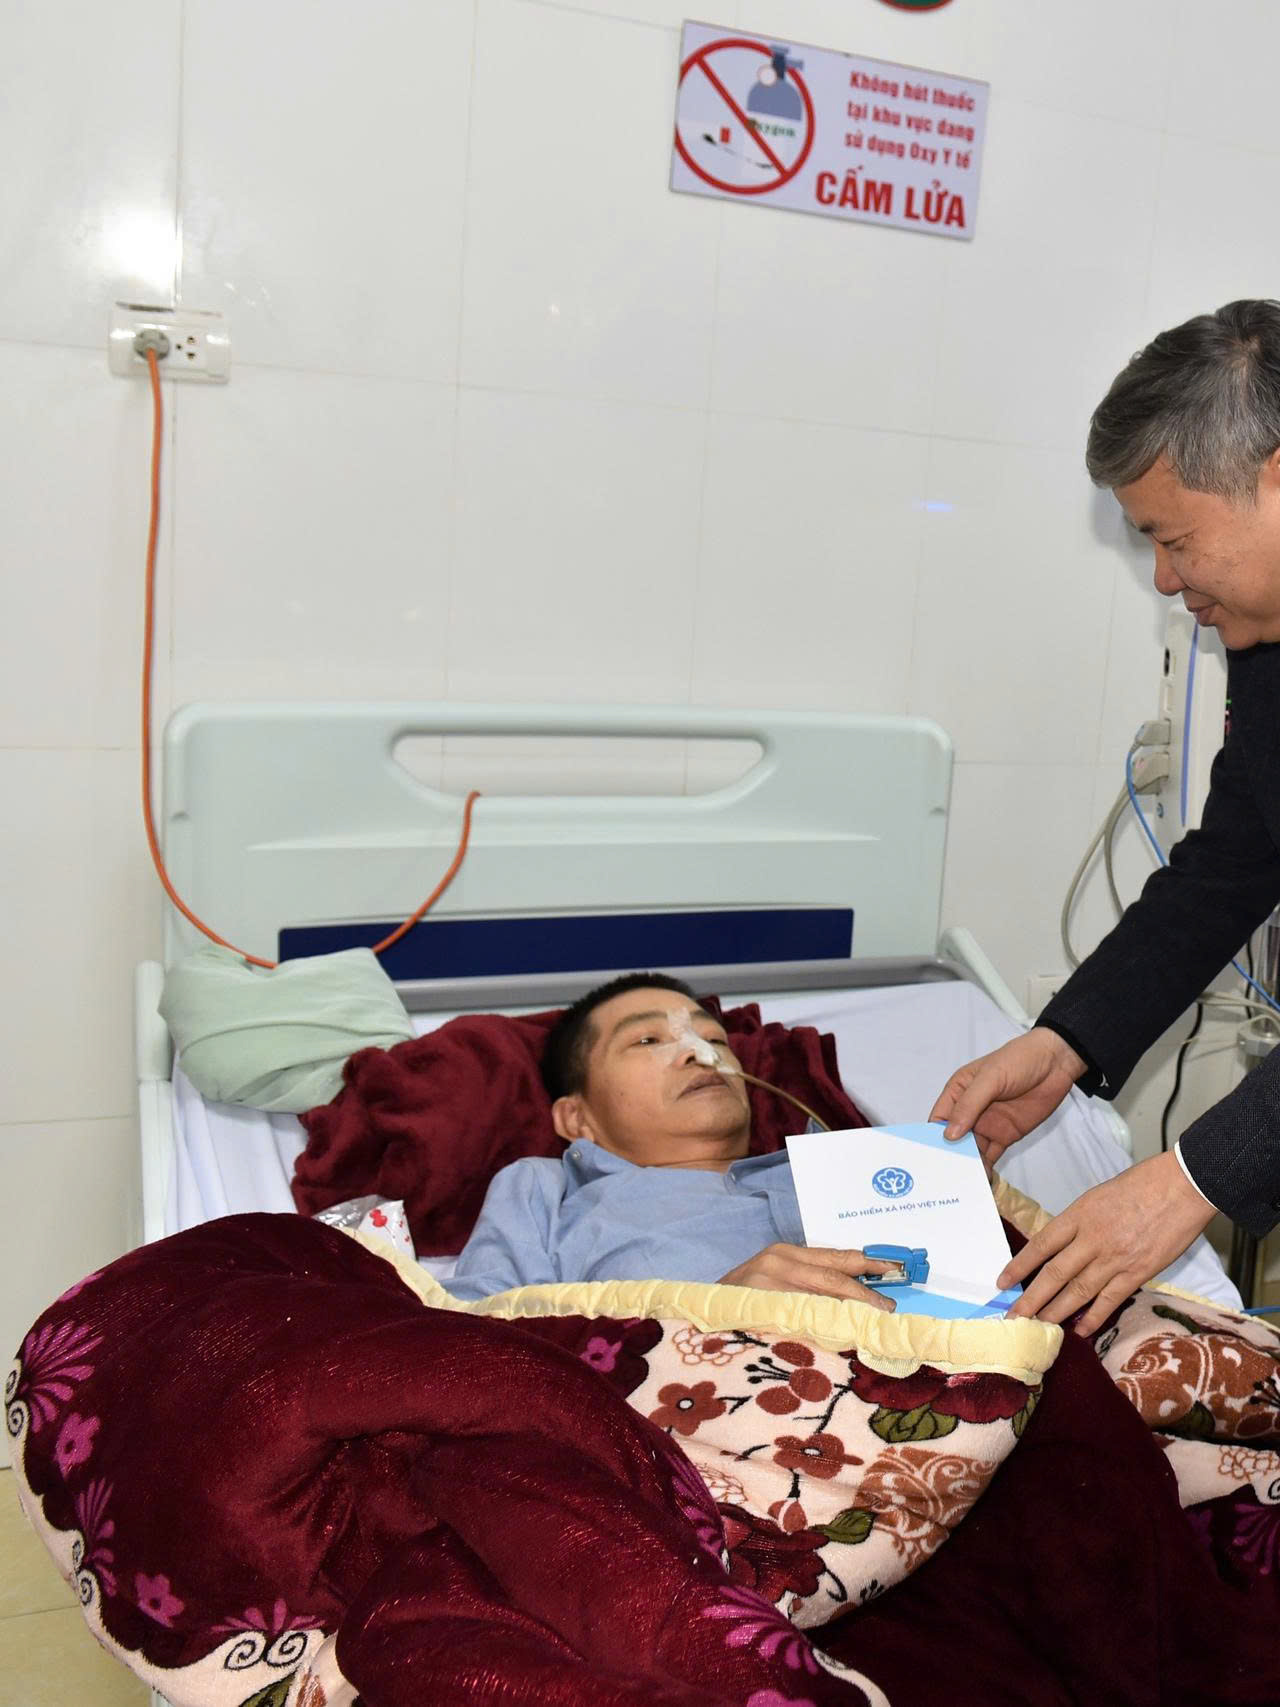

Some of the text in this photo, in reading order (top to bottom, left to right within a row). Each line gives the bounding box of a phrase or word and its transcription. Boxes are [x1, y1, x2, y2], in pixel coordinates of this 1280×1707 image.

[850, 71, 976, 112] Không hút thuốc
[847, 100, 867, 121] tại
[872, 105, 901, 128] khu
[906, 114, 932, 133] vực
[844, 128, 973, 170] sử dụng Oxy Y tế
[814, 165, 966, 229] CẤM LỬA
[938, 1197, 960, 1206] NAM
